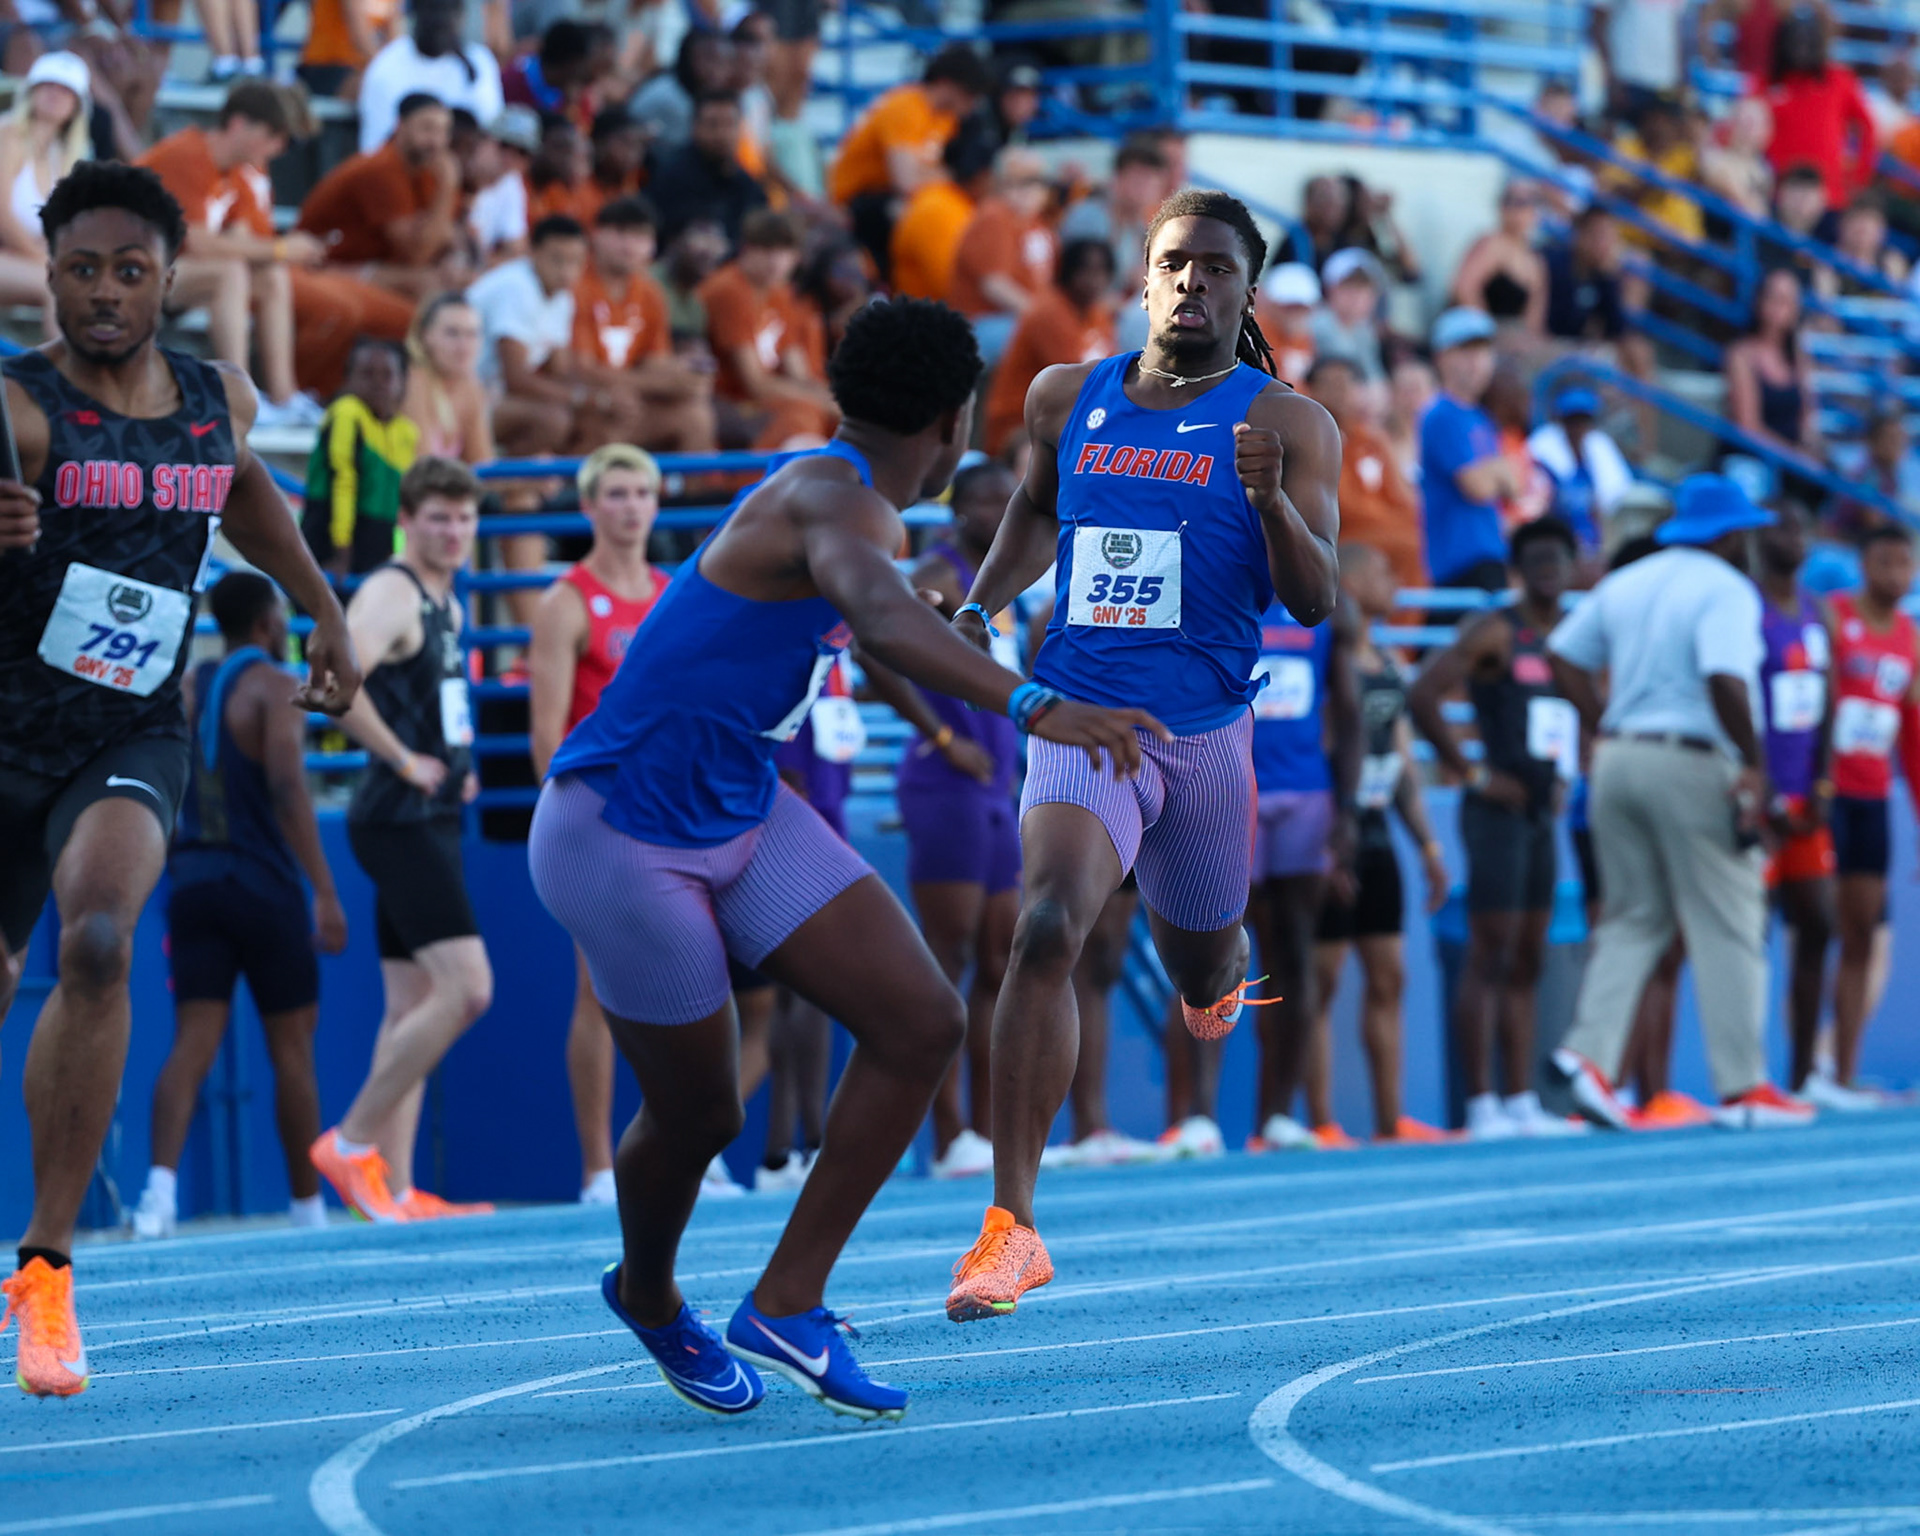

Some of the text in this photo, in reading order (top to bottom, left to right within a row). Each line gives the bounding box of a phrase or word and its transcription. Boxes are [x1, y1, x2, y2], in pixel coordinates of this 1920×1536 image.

[55, 460, 144, 510] OHIO
[1073, 443, 1215, 488] FLORIDA
[1086, 573, 1165, 606] 355
[1092, 605, 1147, 626] GNV '25
[78, 622, 161, 668] 791
[73, 654, 110, 680] GNV
